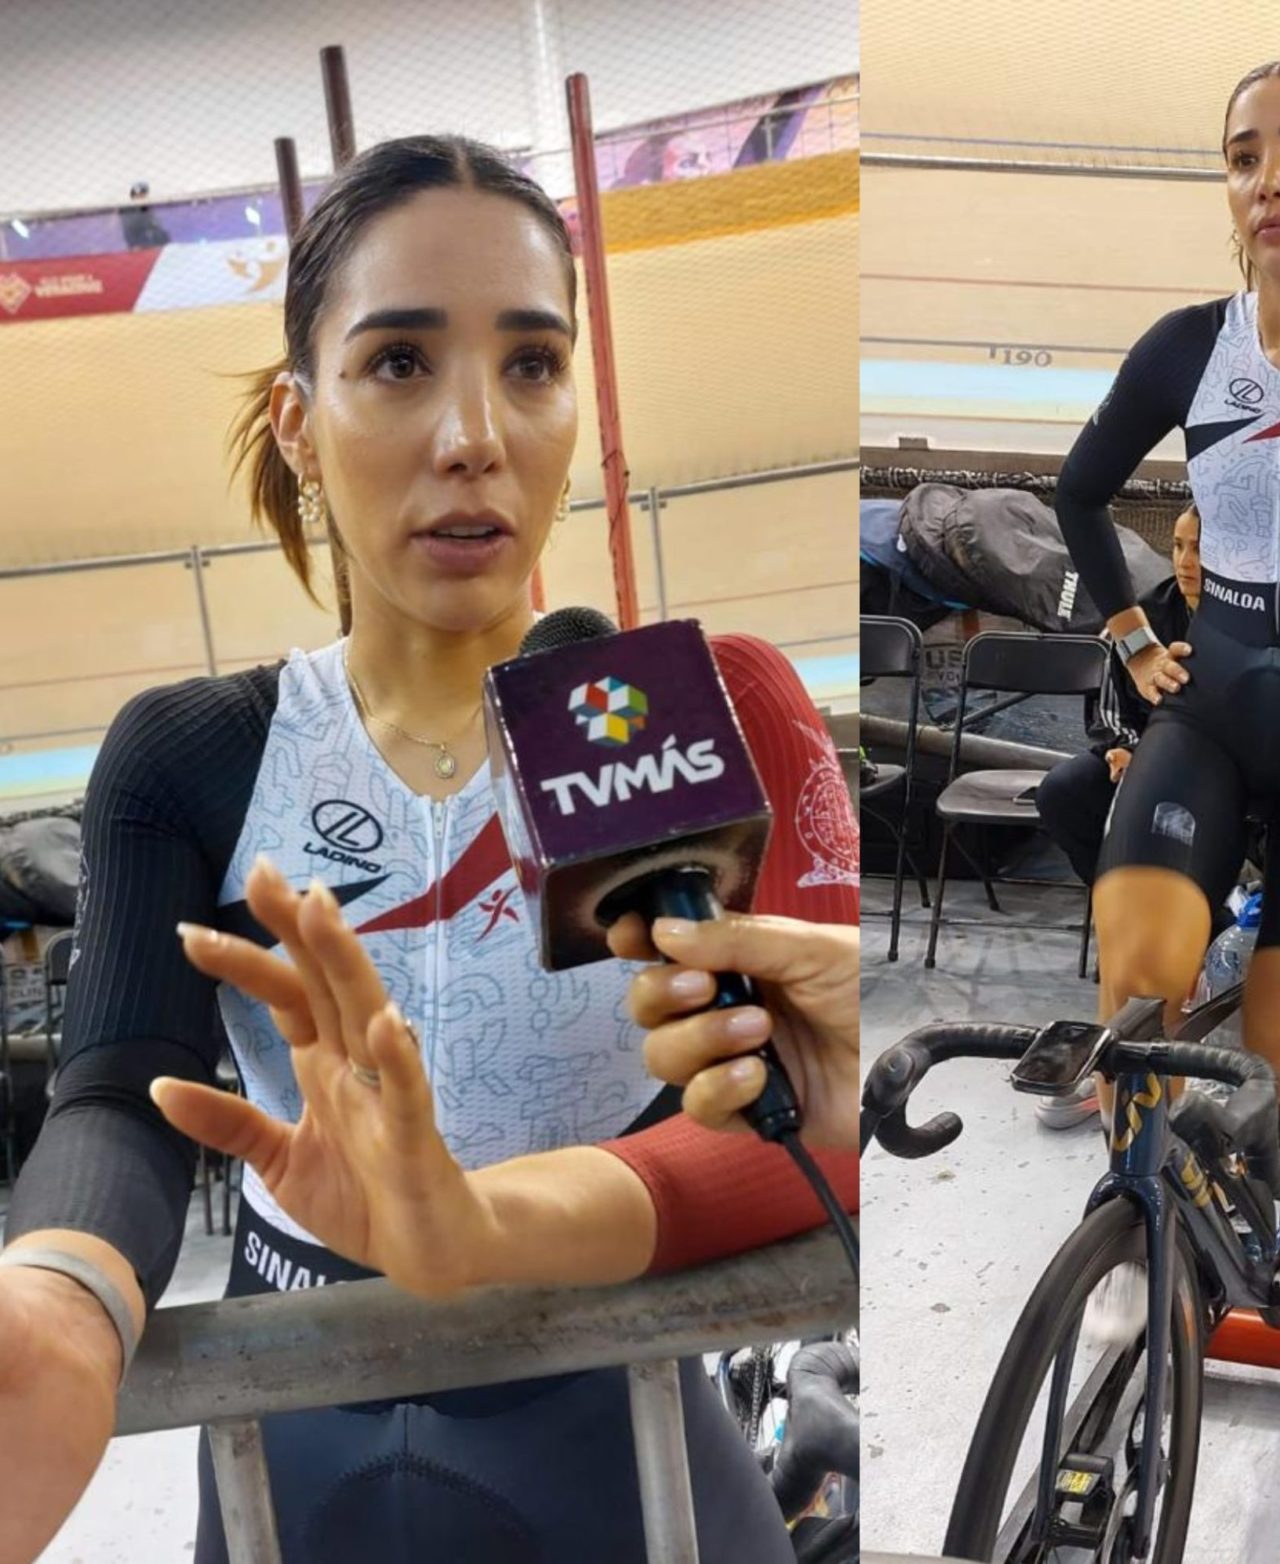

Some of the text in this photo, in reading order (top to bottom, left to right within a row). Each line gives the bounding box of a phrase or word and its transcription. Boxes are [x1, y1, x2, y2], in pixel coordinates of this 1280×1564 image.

[1004, 349, 1053, 368] 190
[1057, 571, 1079, 619] THULE
[1203, 578, 1266, 612] SINALOA
[540, 734, 725, 816] TVMÁS
[302, 841, 382, 874] LADINO
